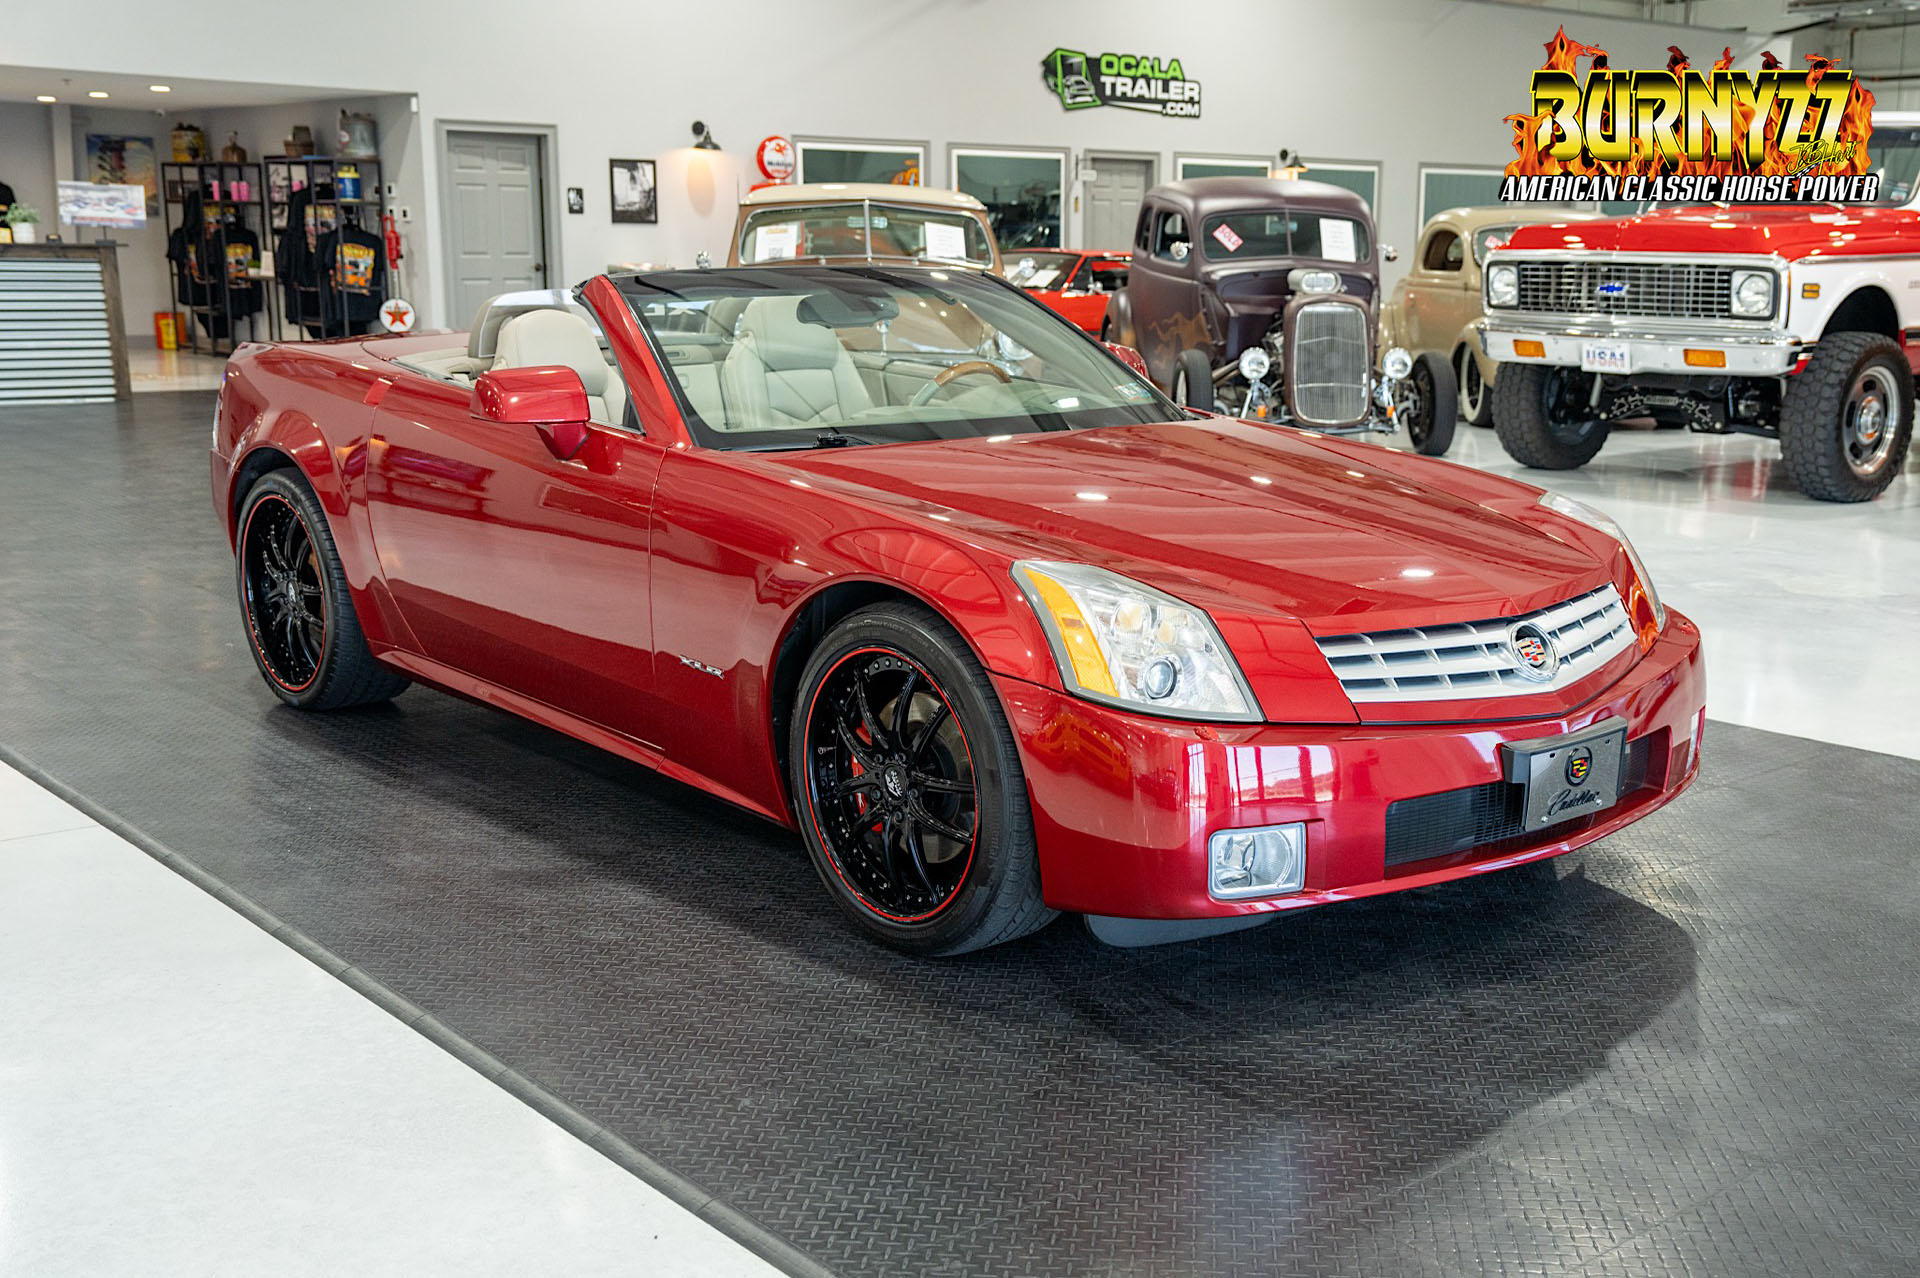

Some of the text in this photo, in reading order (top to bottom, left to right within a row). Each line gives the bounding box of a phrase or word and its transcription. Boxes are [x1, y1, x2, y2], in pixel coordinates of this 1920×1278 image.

[1100, 53, 1185, 81] OCALA
[1100, 75, 1200, 102] TRAILER
[1162, 101, 1200, 117] .COM
[1547, 788, 1600, 816] Cadillac
